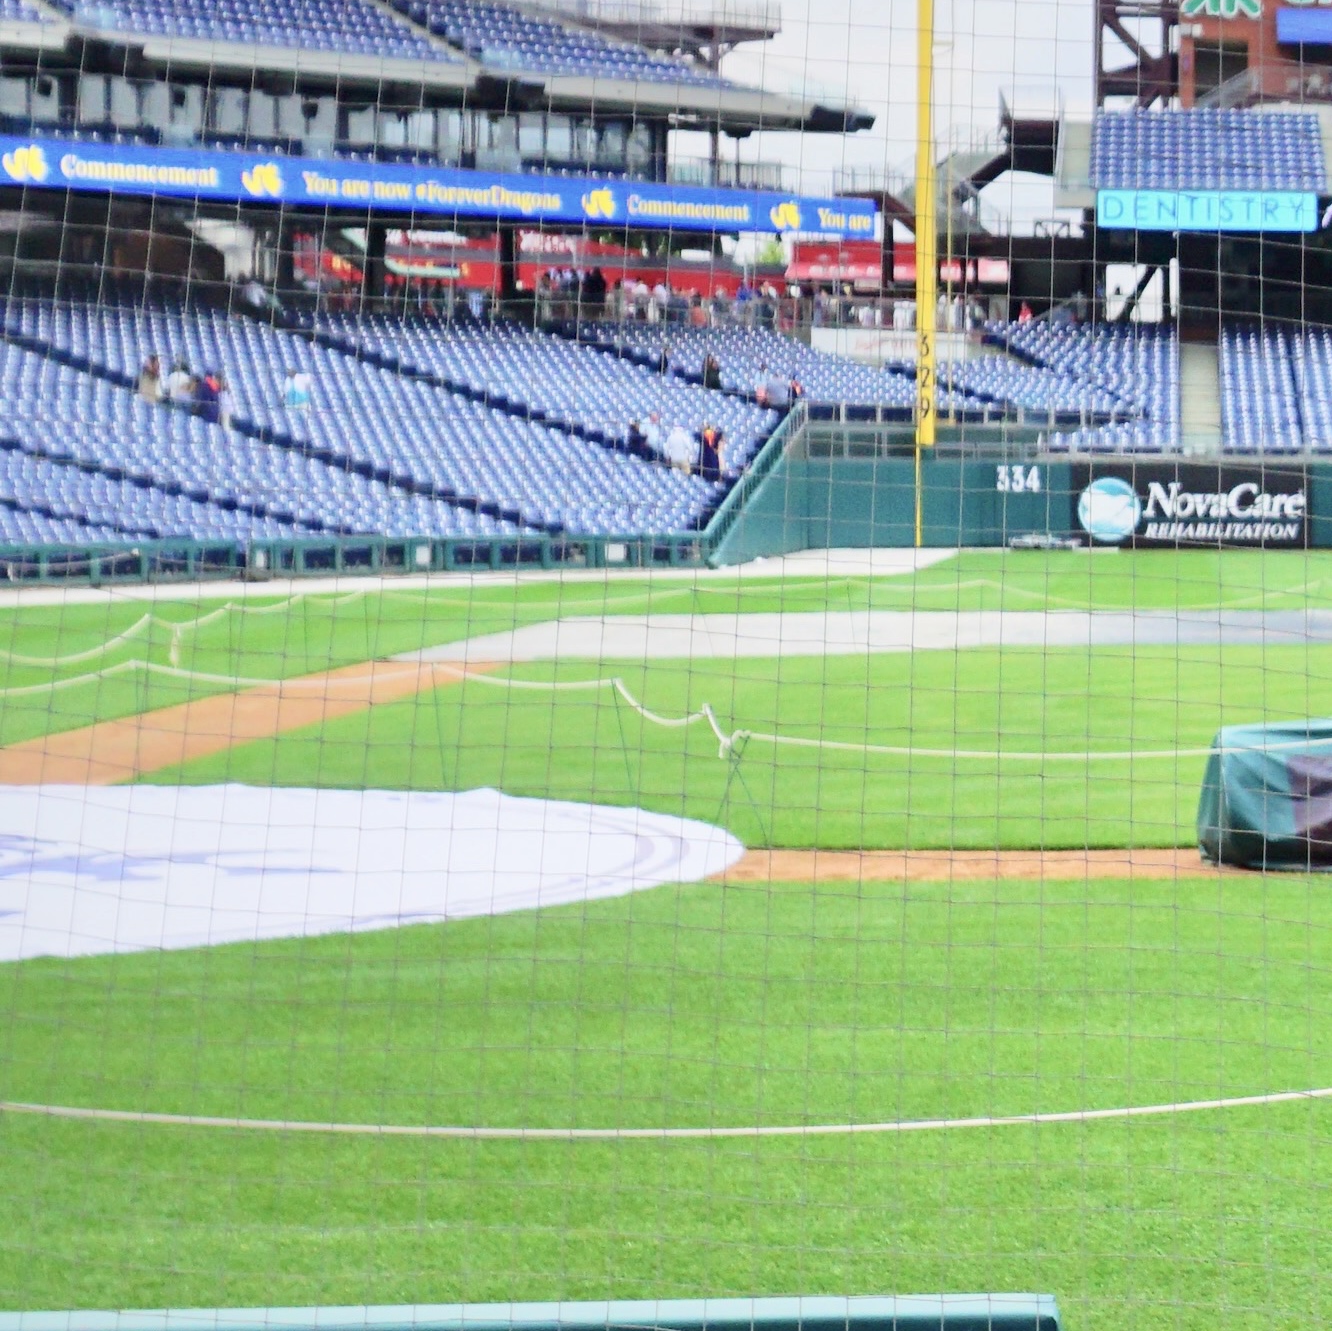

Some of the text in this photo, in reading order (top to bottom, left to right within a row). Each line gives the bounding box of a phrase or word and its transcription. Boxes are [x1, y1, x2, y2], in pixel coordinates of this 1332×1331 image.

[60, 152, 219, 187] Commencement
[302, 171, 337, 195] You
[341, 178, 370, 198] are
[373, 180, 411, 200] now
[626, 194, 750, 223] Commencement
[817, 207, 845, 229] You
[848, 213, 871, 230] are
[1102, 194, 1304, 223] DENTISTRY
[1143, 481, 1304, 519] NovaCare
[1144, 521, 1300, 540] REHABILITATION
